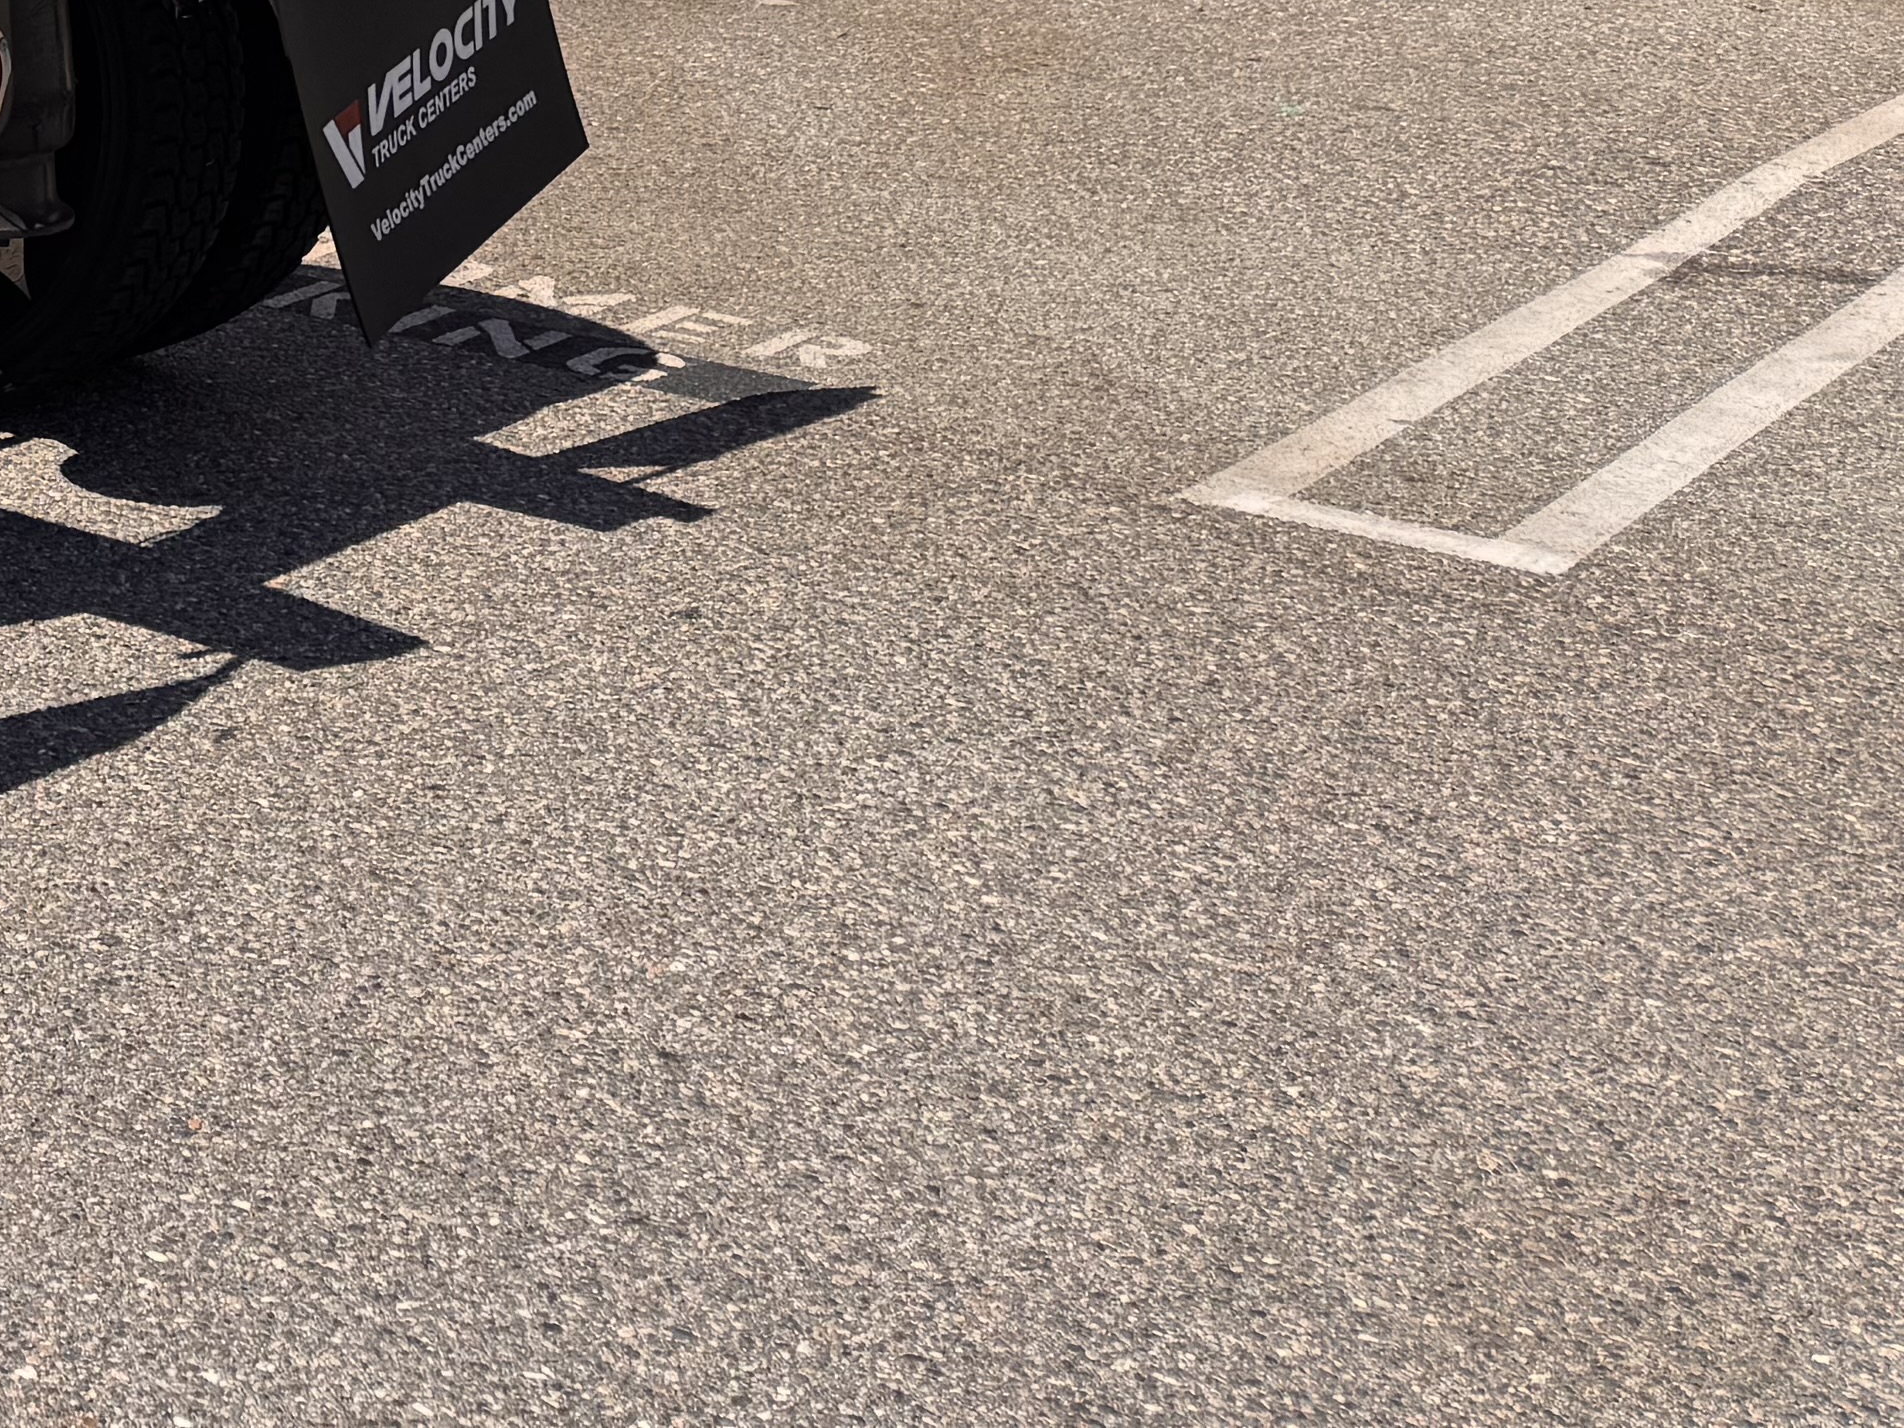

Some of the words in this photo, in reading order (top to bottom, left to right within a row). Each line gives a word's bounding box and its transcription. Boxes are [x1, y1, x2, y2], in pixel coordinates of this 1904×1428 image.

[370, 88, 538, 243] VelocityTruckCenters.com
[371, 119, 417, 168] TRUCK
[417, 65, 478, 138] CENTERS
